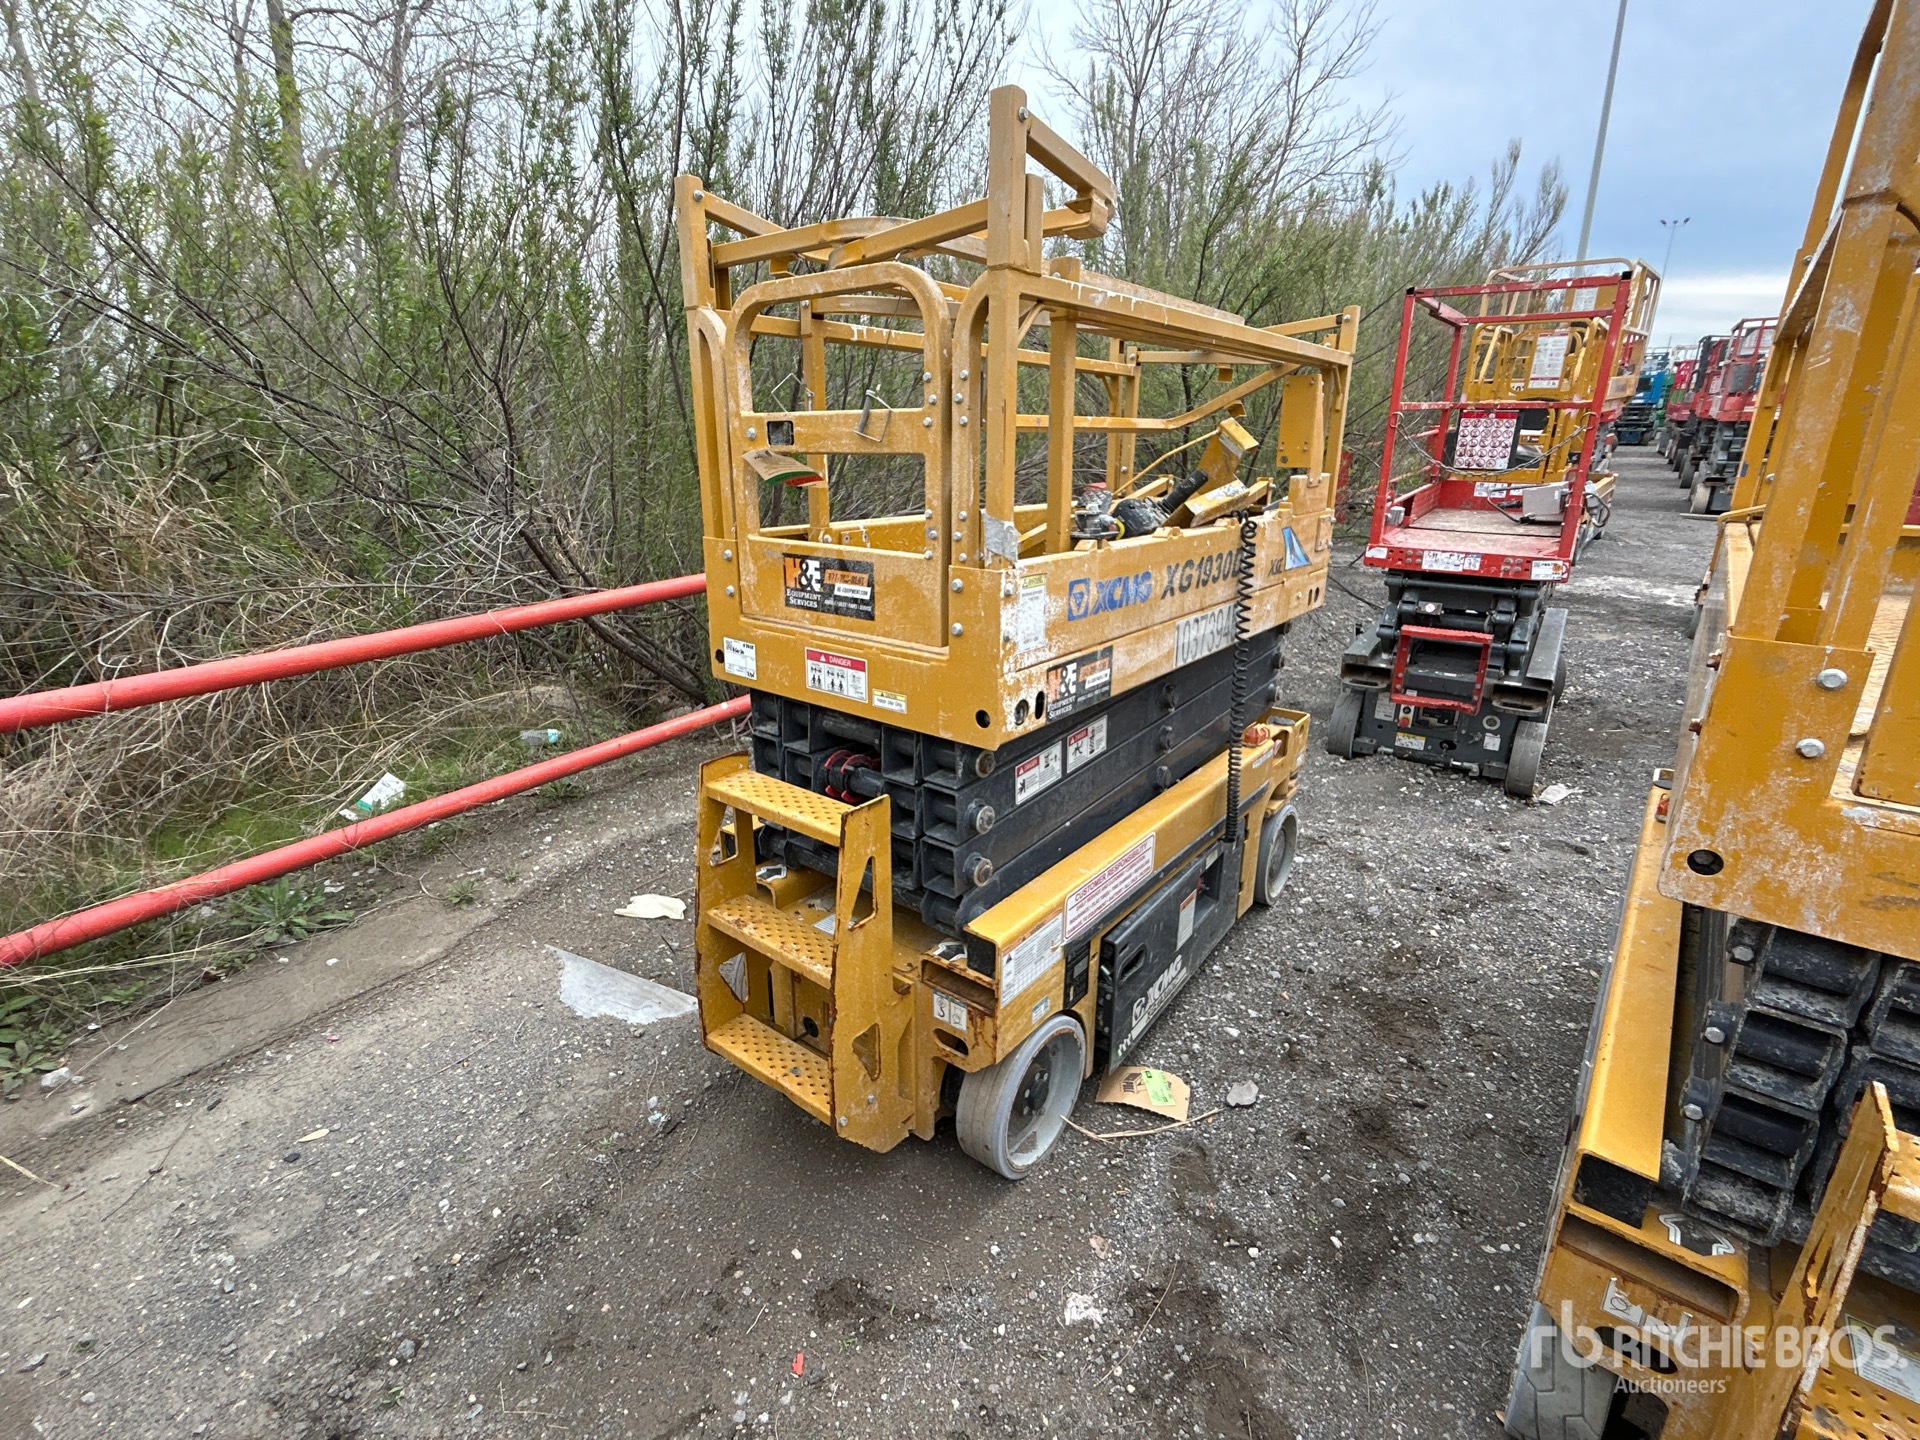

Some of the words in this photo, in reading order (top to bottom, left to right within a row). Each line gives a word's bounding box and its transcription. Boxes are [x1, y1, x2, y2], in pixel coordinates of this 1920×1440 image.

[783, 557, 821, 592] H&E
[786, 589, 821, 601] EQUIPMENT
[789, 596, 818, 608] SERVICES
[1090, 570, 1153, 615] XCMG
[828, 656, 852, 667] DANGER
[1075, 873, 1107, 901] CUSTOMER
[1106, 842, 1148, 878] RESPONSIBILITY
